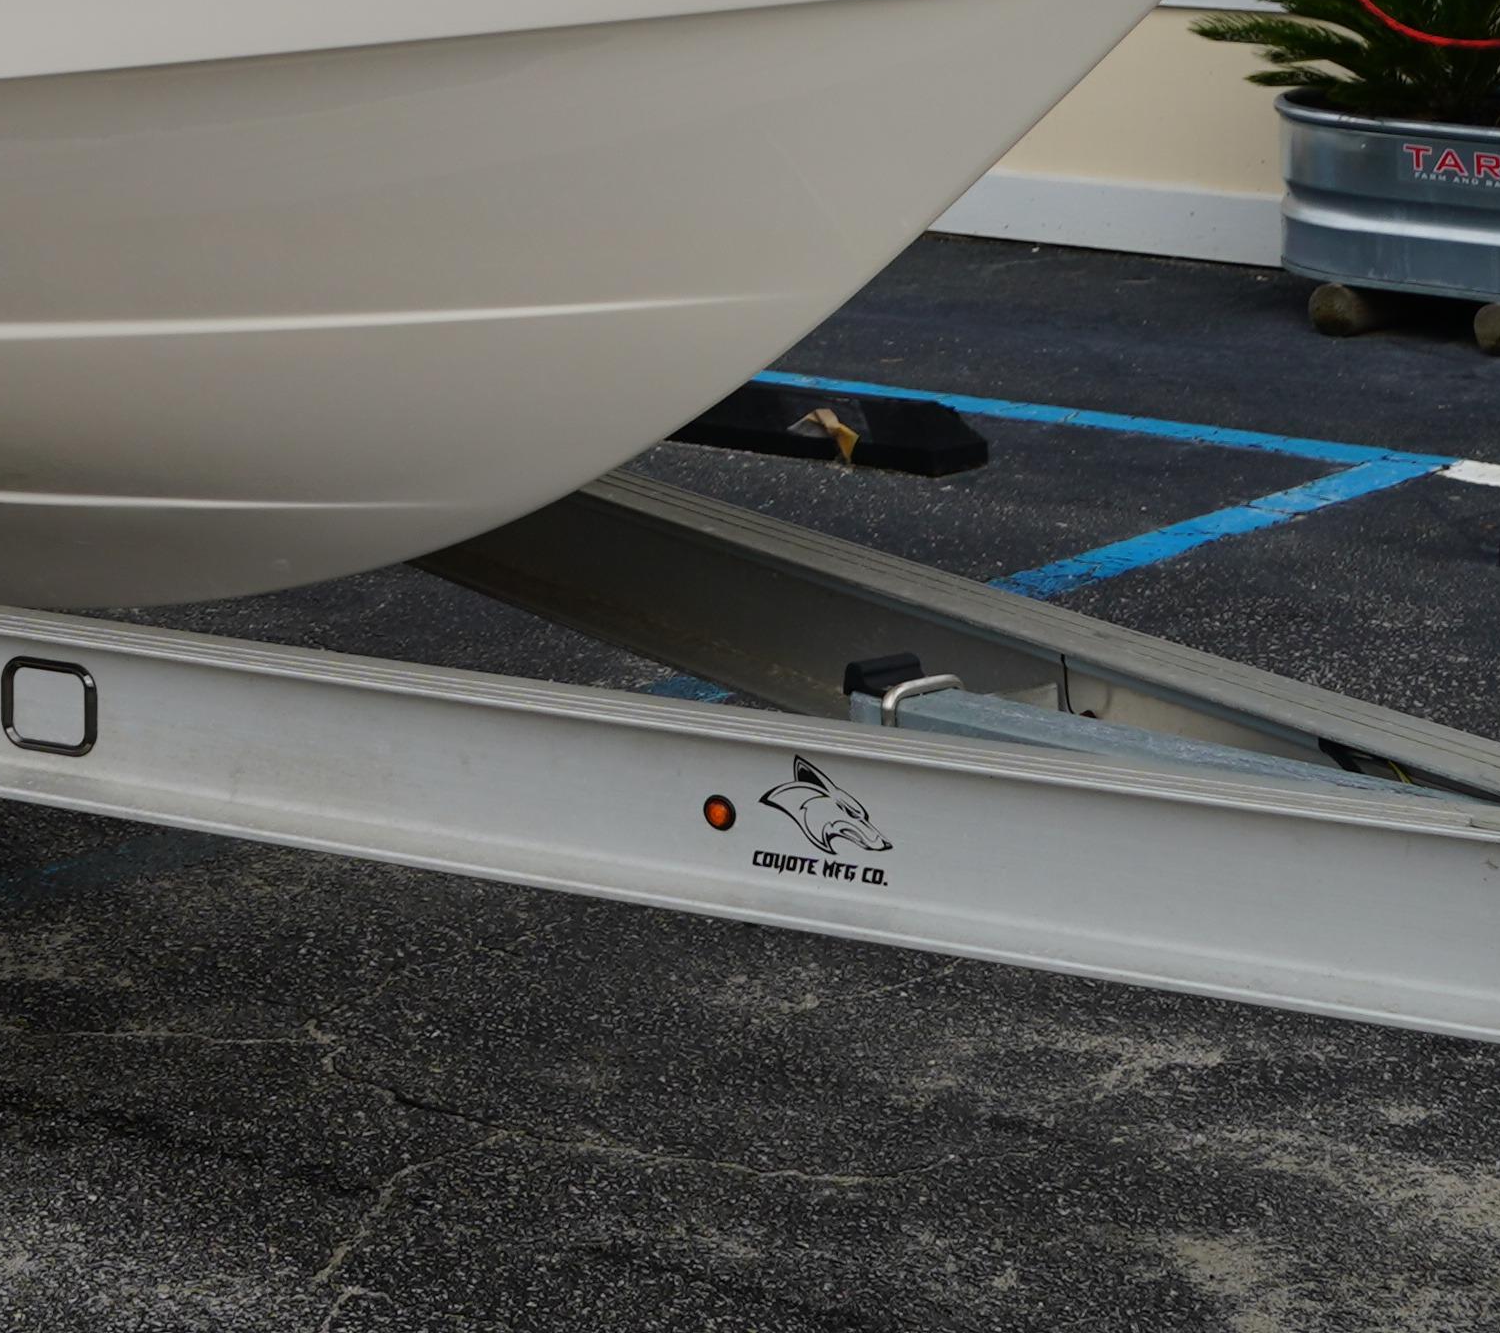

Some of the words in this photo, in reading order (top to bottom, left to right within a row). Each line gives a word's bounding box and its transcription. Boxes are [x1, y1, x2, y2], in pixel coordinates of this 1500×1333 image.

[1414, 171, 1447, 182] FARM
[1453, 176, 1479, 186] AND
[752, 850, 819, 874] COYOTE
[823, 858, 858, 883] MFG
[861, 867, 888, 886] CO.
